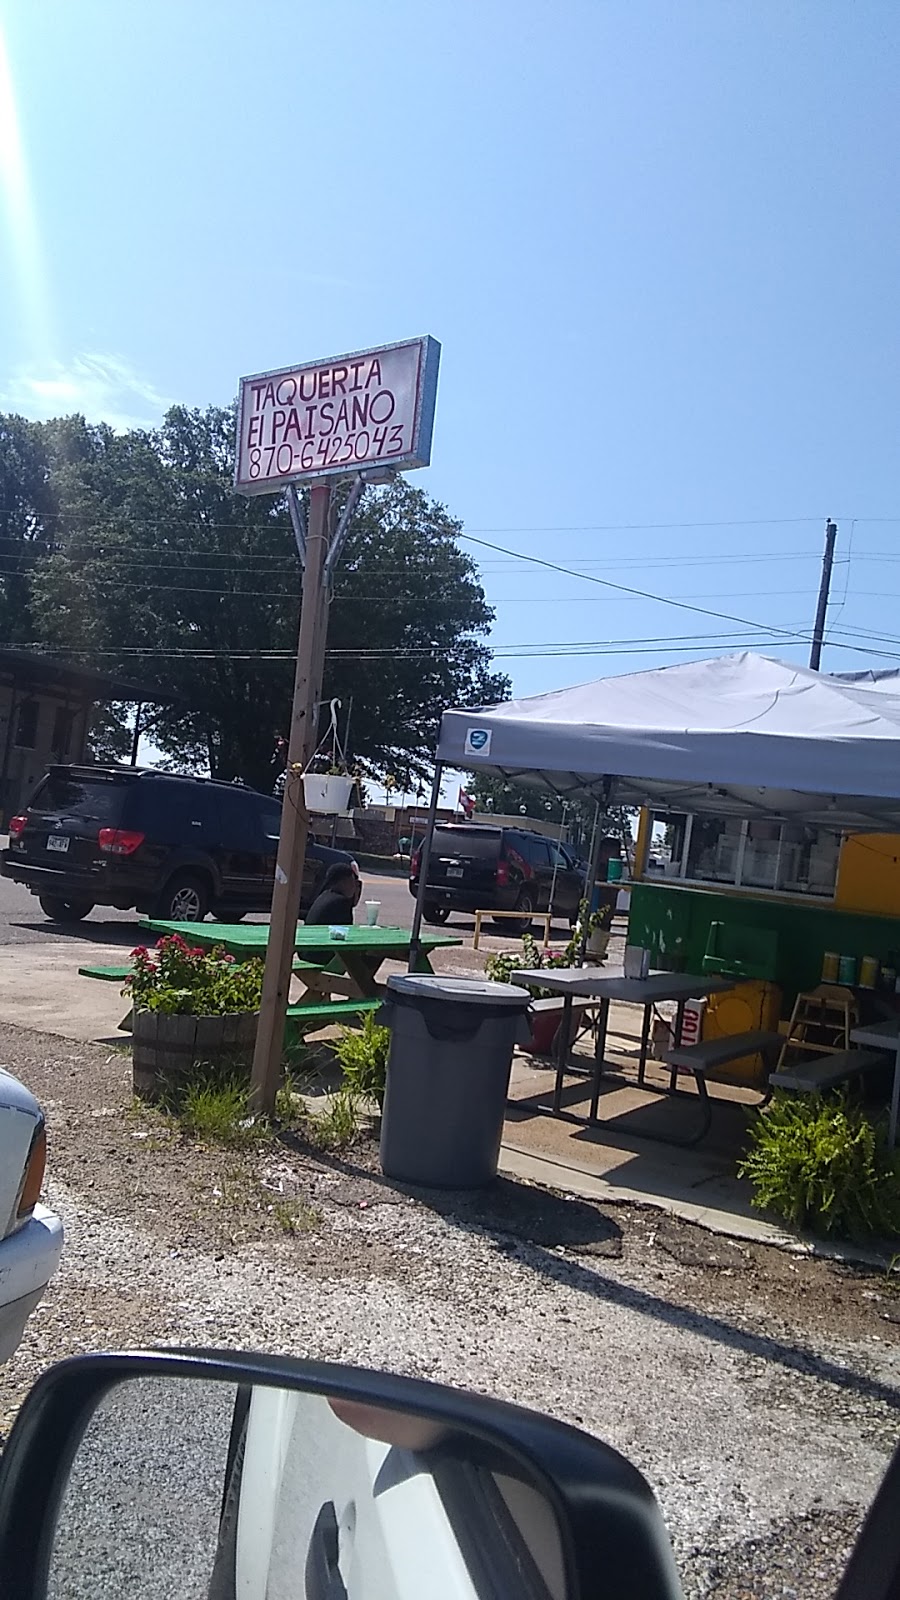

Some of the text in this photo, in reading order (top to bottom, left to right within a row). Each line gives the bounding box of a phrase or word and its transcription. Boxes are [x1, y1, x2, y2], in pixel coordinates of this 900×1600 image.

[251, 359, 382, 412] TAQUERIA
[271, 390, 395, 445] PAISANO
[249, 425, 404, 478] 870-6425043
